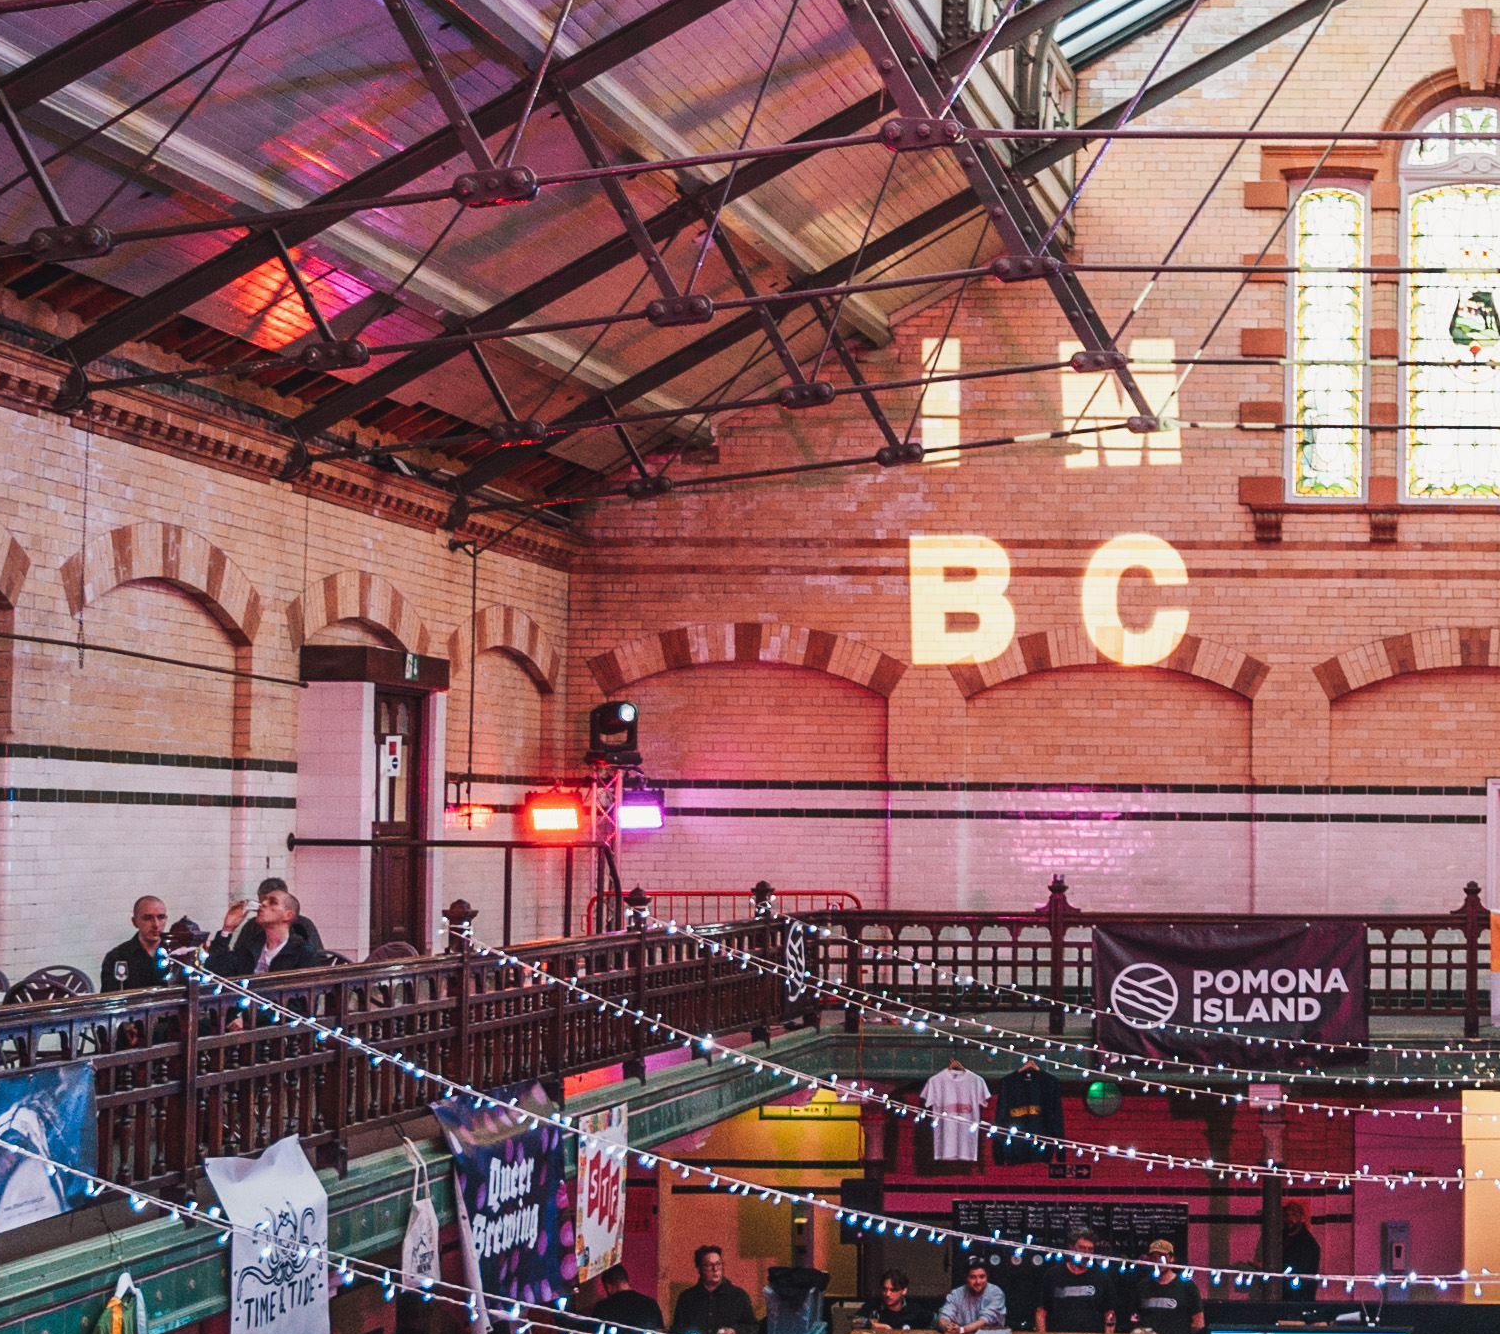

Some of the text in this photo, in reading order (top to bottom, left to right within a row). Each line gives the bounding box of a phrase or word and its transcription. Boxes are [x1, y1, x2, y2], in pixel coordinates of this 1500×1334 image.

[1192, 967, 1350, 995] POMONA
[1192, 996, 1323, 1024] ISLAND
[487, 1156, 536, 1214] Queer
[471, 1197, 541, 1259] Brewing
[243, 1273, 316, 1330] TIME & TIDE
